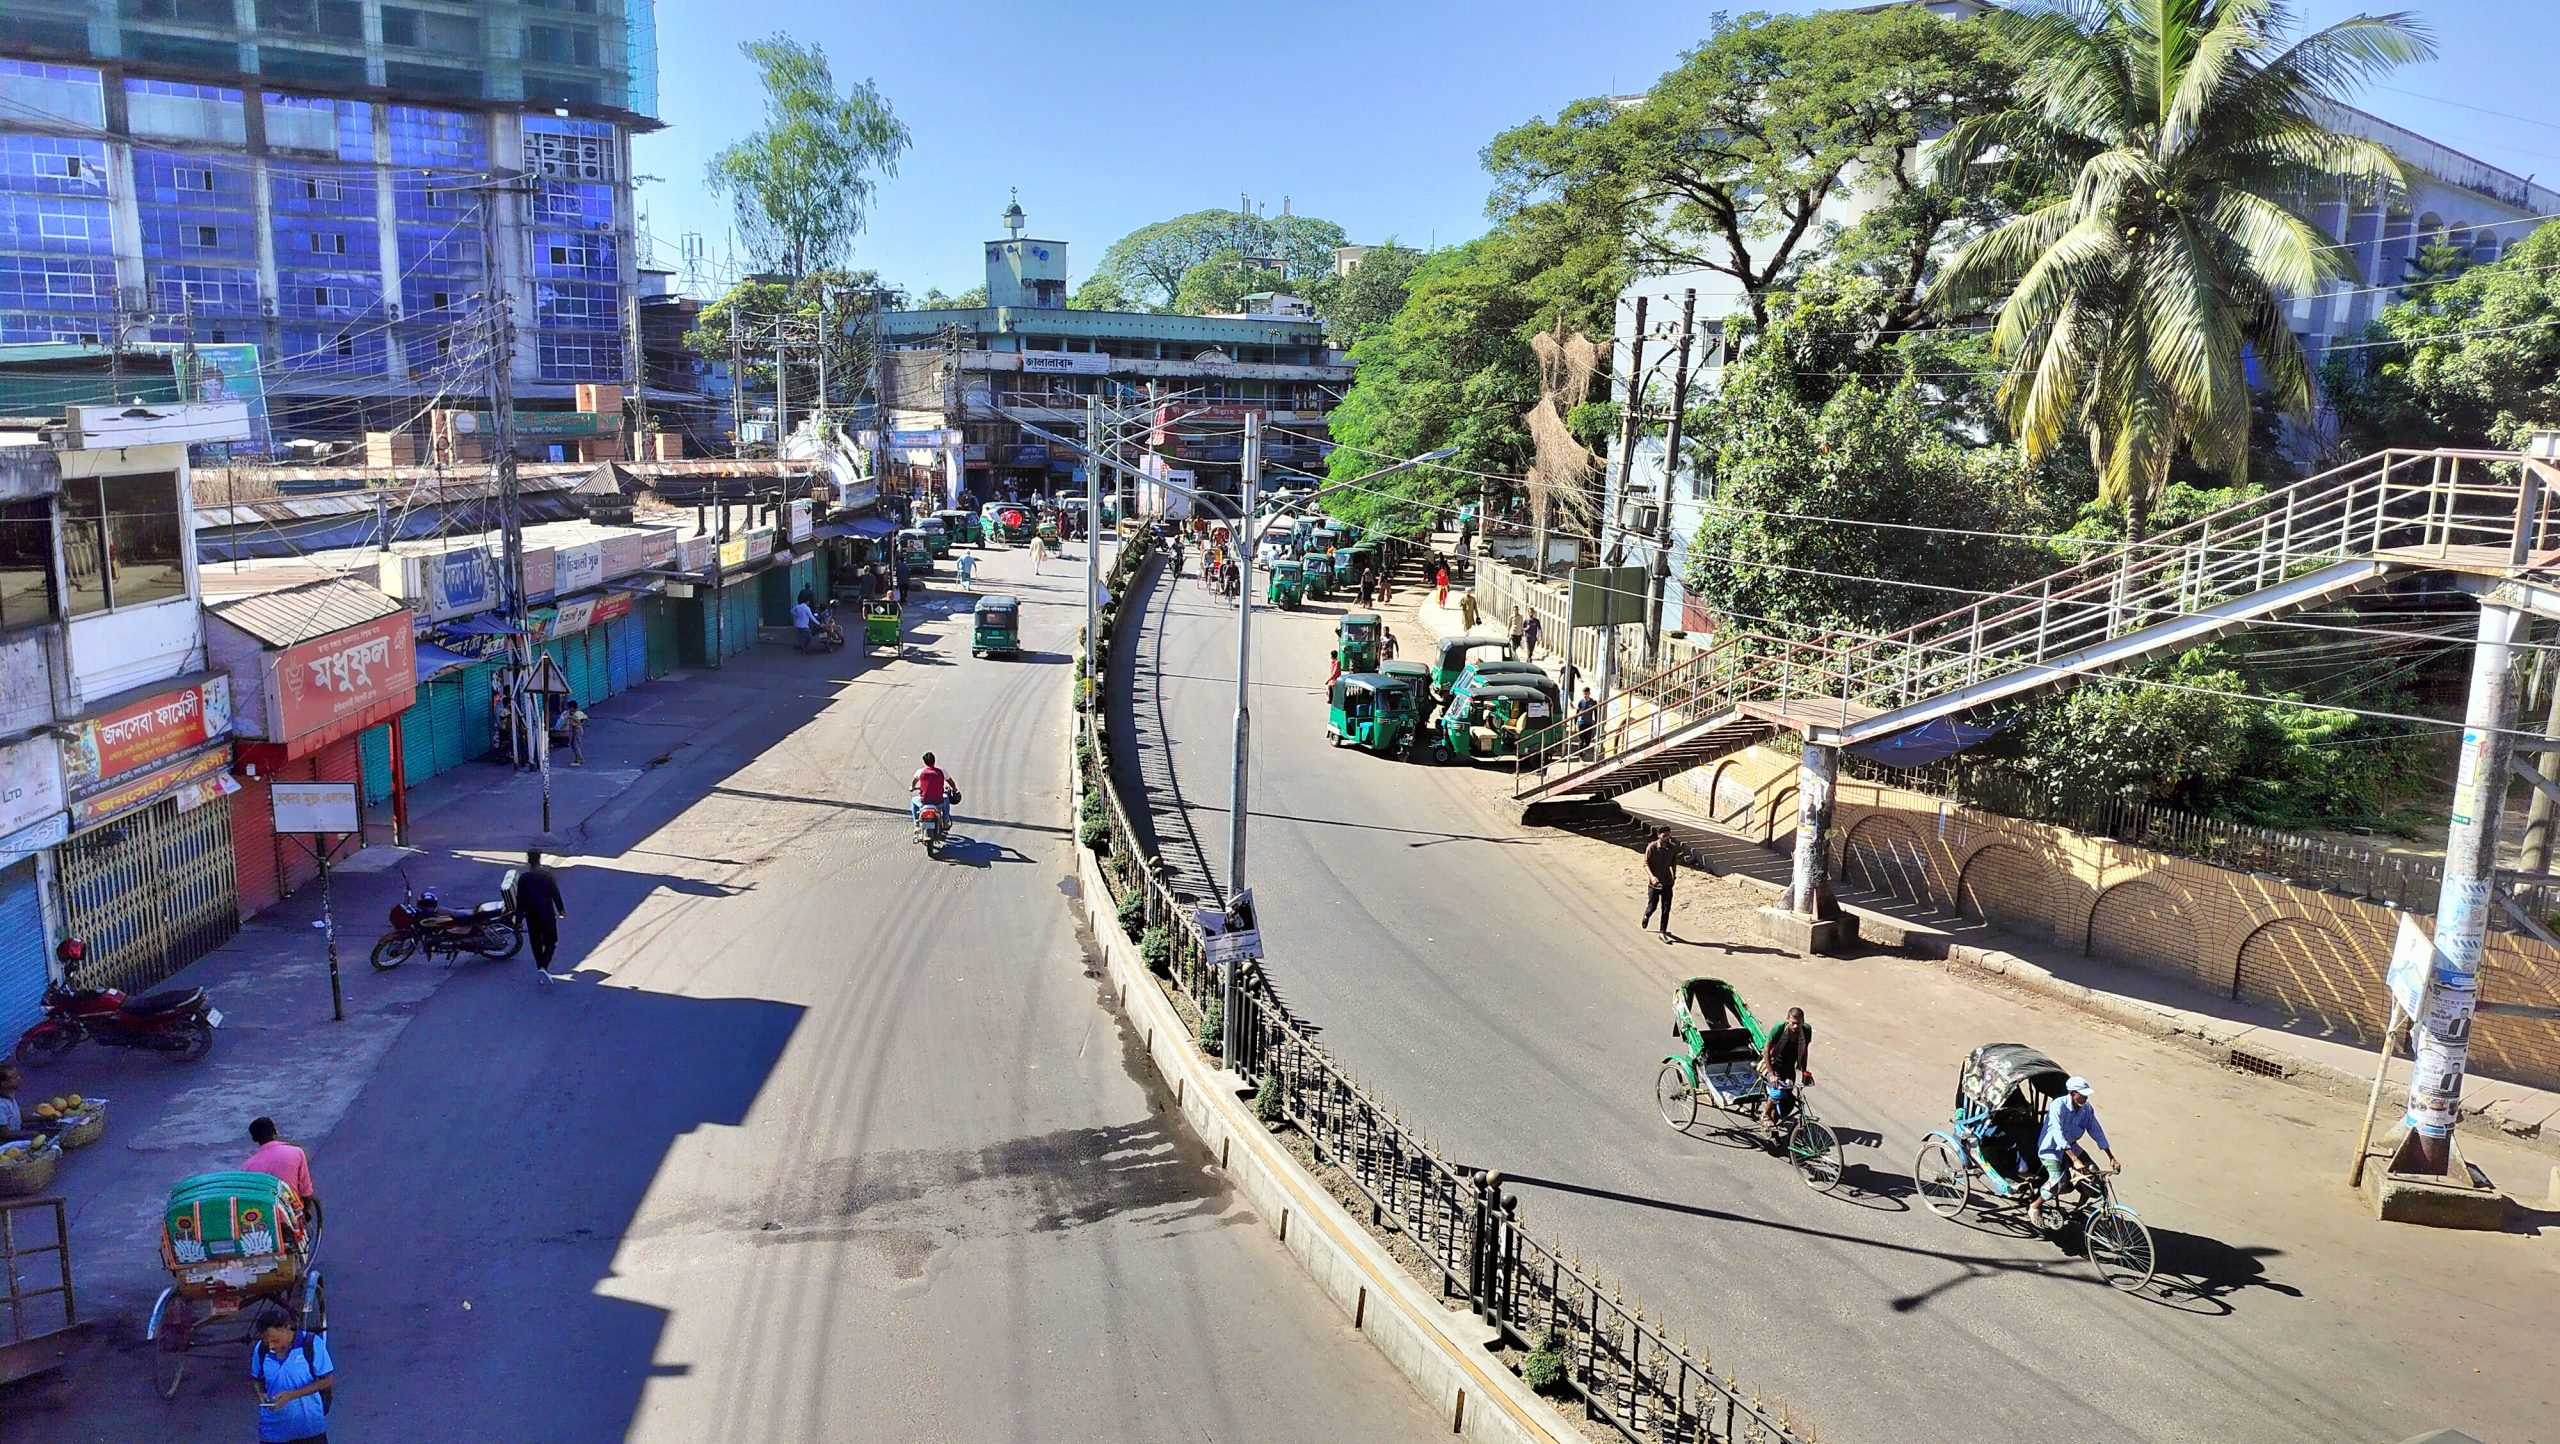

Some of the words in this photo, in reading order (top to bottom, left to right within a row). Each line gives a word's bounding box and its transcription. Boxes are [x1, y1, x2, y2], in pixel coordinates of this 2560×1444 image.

[1025, 357, 1074, 369] জালালাবাদ
[308, 635, 391, 693] মধুফুল
[101, 711, 153, 746] জনসেবা
[156, 690, 199, 728] ফার্মেসী
[2, 787, 23, 804] LTD
[97, 776, 164, 812] জনসেবা
